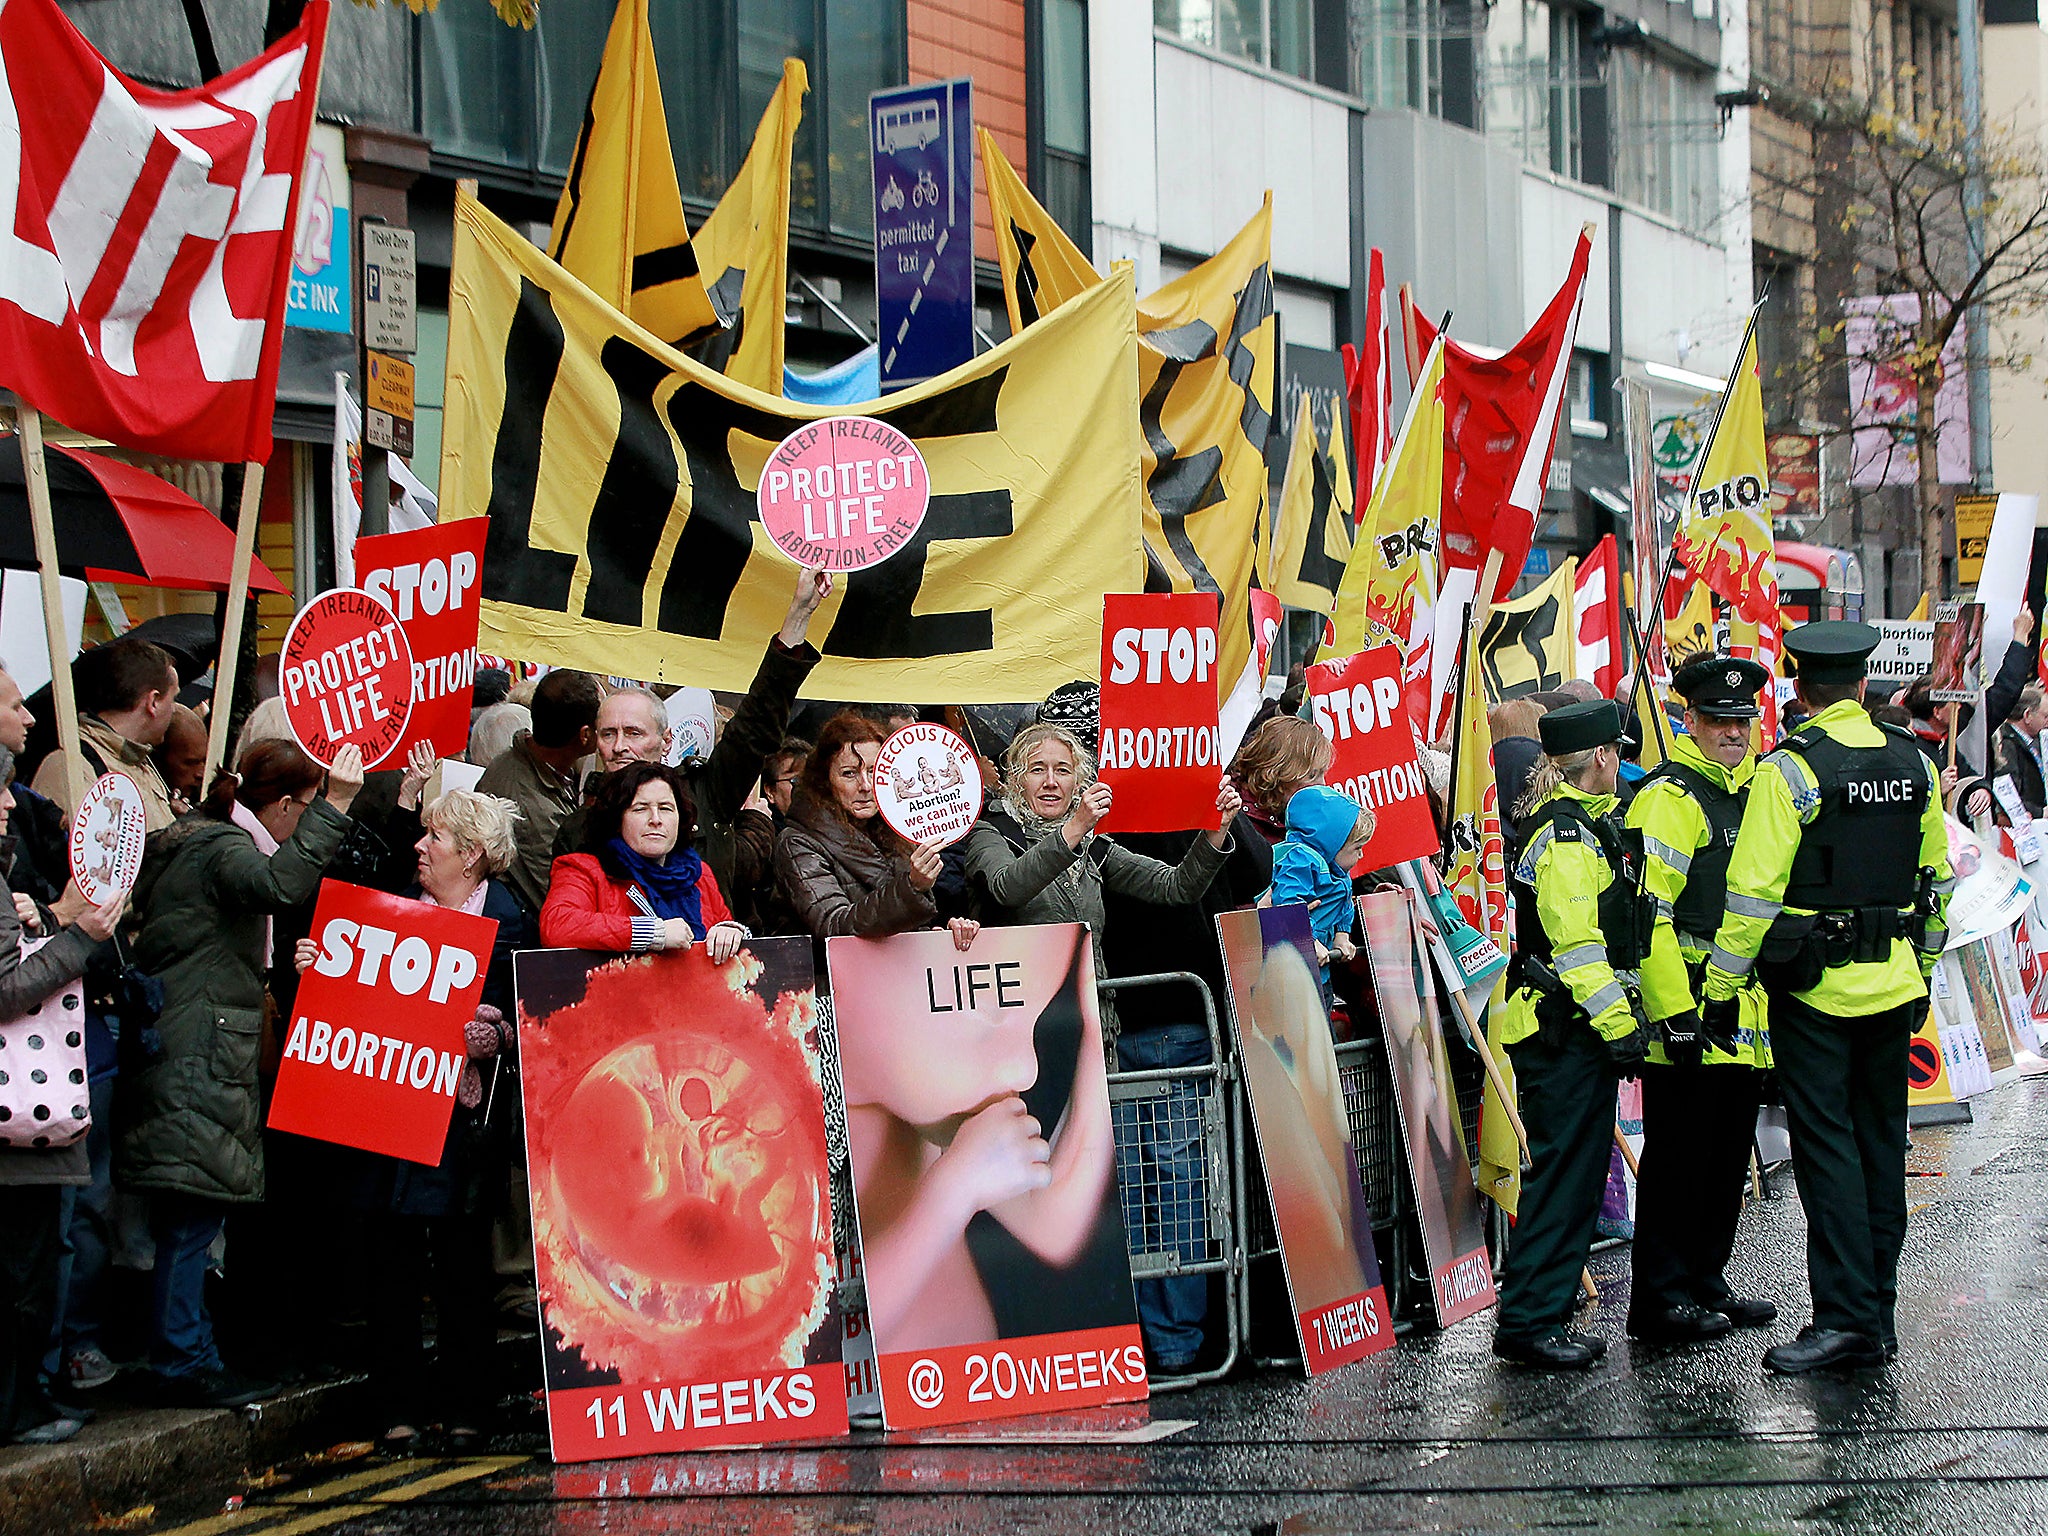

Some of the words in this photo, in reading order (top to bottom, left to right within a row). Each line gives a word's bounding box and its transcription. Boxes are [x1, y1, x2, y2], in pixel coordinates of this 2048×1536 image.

[881, 218, 935, 251] permitted
[898, 249, 919, 273] taxi
[311, 283, 340, 314] INK
[478, 274, 1014, 660] LIFE
[777, 428, 819, 467] KEEP
[830, 420, 908, 456] IRELAND
[768, 455, 916, 505] PROTECT
[778, 517, 915, 567] ABORTION-FREE
[803, 494, 888, 543] LIFE
[364, 551, 477, 622] STOP
[287, 612, 316, 661] KEEP
[320, 594, 386, 627] IRELAND
[1875, 626, 1934, 641] bortion
[1896, 644, 1910, 656] is
[285, 623, 399, 707] PROTECT
[411, 646, 477, 704] RTION
[1109, 626, 1217, 685] STOP
[308, 694, 409, 763] ABOON-FREE
[319, 674, 390, 743] LIFE
[1312, 676, 1400, 743] STOP
[876, 727, 937, 786] PRECIOUS
[941, 732, 972, 764] LIFE
[1099, 725, 1223, 769] ABORTION
[908, 788, 961, 813] Abortion?
[1329, 759, 1426, 810] ORTION
[1847, 778, 1914, 804] POLICE
[73, 801, 97, 898] PRECIOUS
[91, 776, 116, 802] LIFE
[127, 806, 138, 832] live
[904, 815, 924, 828] we
[927, 807, 948, 821] can
[949, 801, 971, 816] live
[911, 817, 960, 841] without
[961, 814, 972, 826] it
[114, 810, 129, 878] Abortion?
[125, 837, 133, 863] can
[126, 829, 142, 888] without
[137, 813, 145, 823] it
[120, 868, 127, 889] we
[313, 917, 478, 1004] STOP
[926, 961, 1025, 1013] LIFE
[284, 1016, 464, 1098] ABORTION
[1440, 1273, 1455, 1309] 20
[1449, 1254, 1488, 1304] WEEKS
[1312, 1318, 1324, 1355] 7
[1322, 1296, 1380, 1350] WEEKS
[585, 1397, 628, 1439] 11
[642, 1373, 816, 1433] WEEKS
[907, 1358, 945, 1409] @
